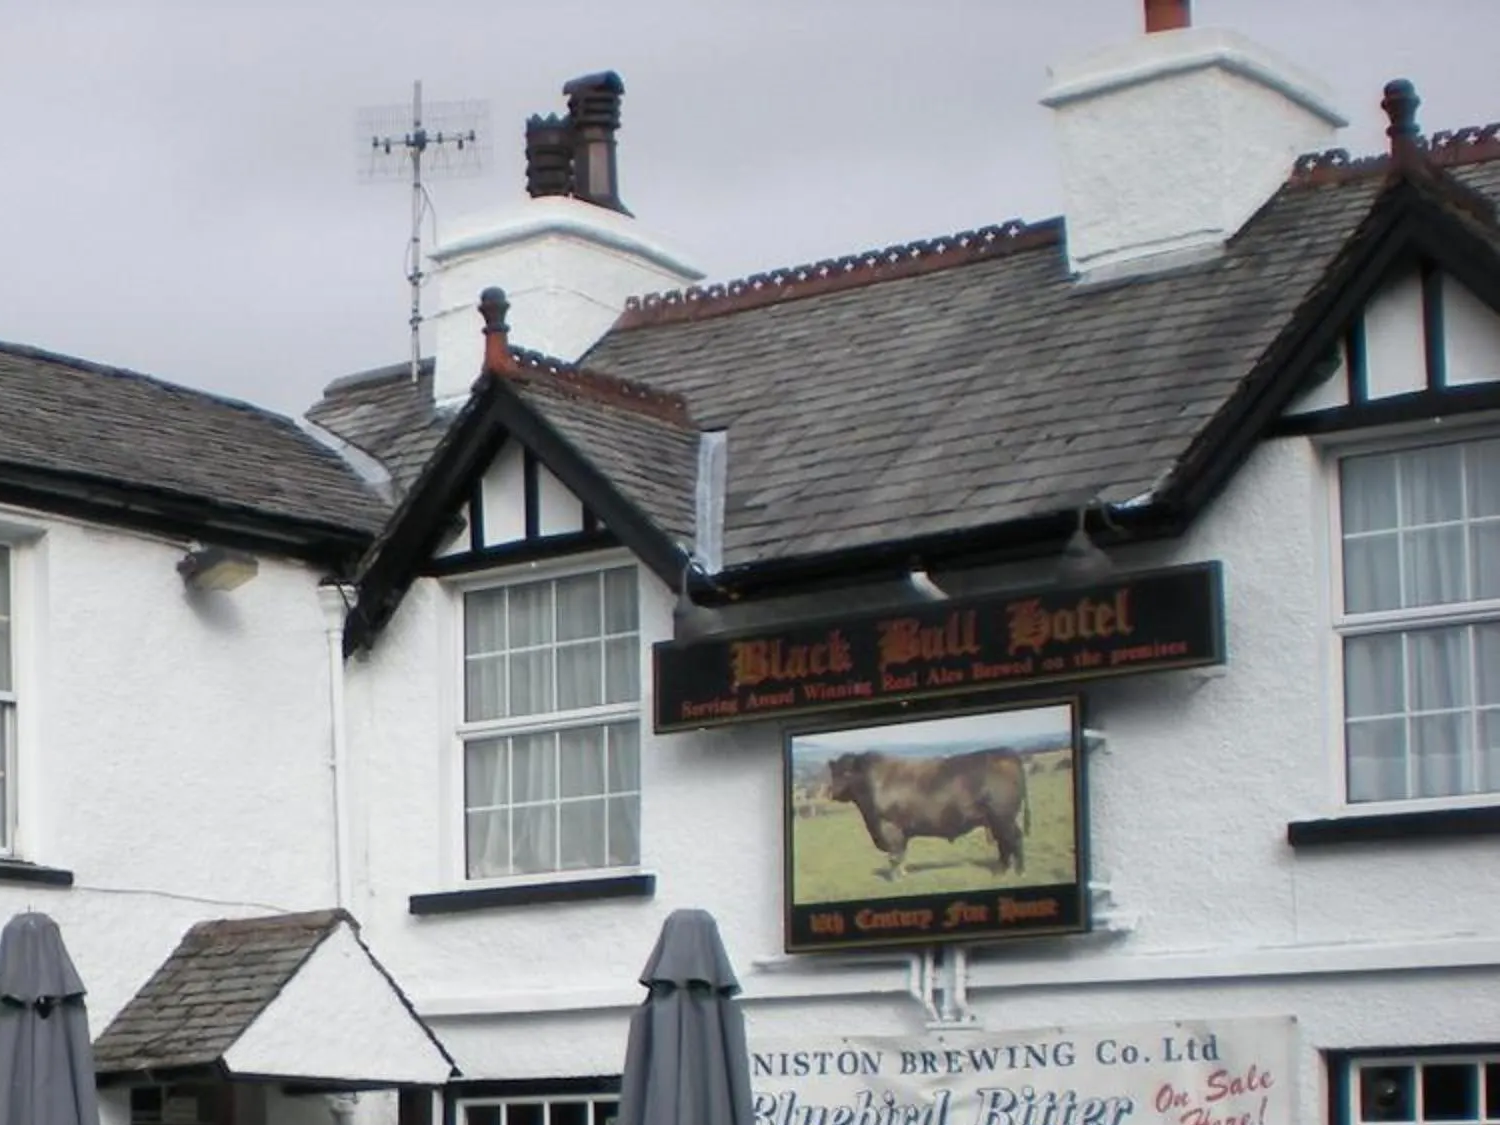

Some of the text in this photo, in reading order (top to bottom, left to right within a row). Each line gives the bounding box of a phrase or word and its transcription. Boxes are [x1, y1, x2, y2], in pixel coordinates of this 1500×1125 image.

[730, 588, 1135, 687] Black Bull Hotel
[681, 697, 738, 720] Serving
[746, 688, 795, 709] Award
[803, 679, 873, 702] Winning
[881, 671, 918, 692] Real
[926, 665, 964, 686] Ales
[1042, 656, 1064, 671] on
[1073, 650, 1101, 667] the
[1110, 640, 1188, 664] premises
[853, 907, 934, 931] Century
[753, 1034, 1221, 1077] NISTON BREWING Co. Ltd
[1154, 1064, 1275, 1114] On Sale
